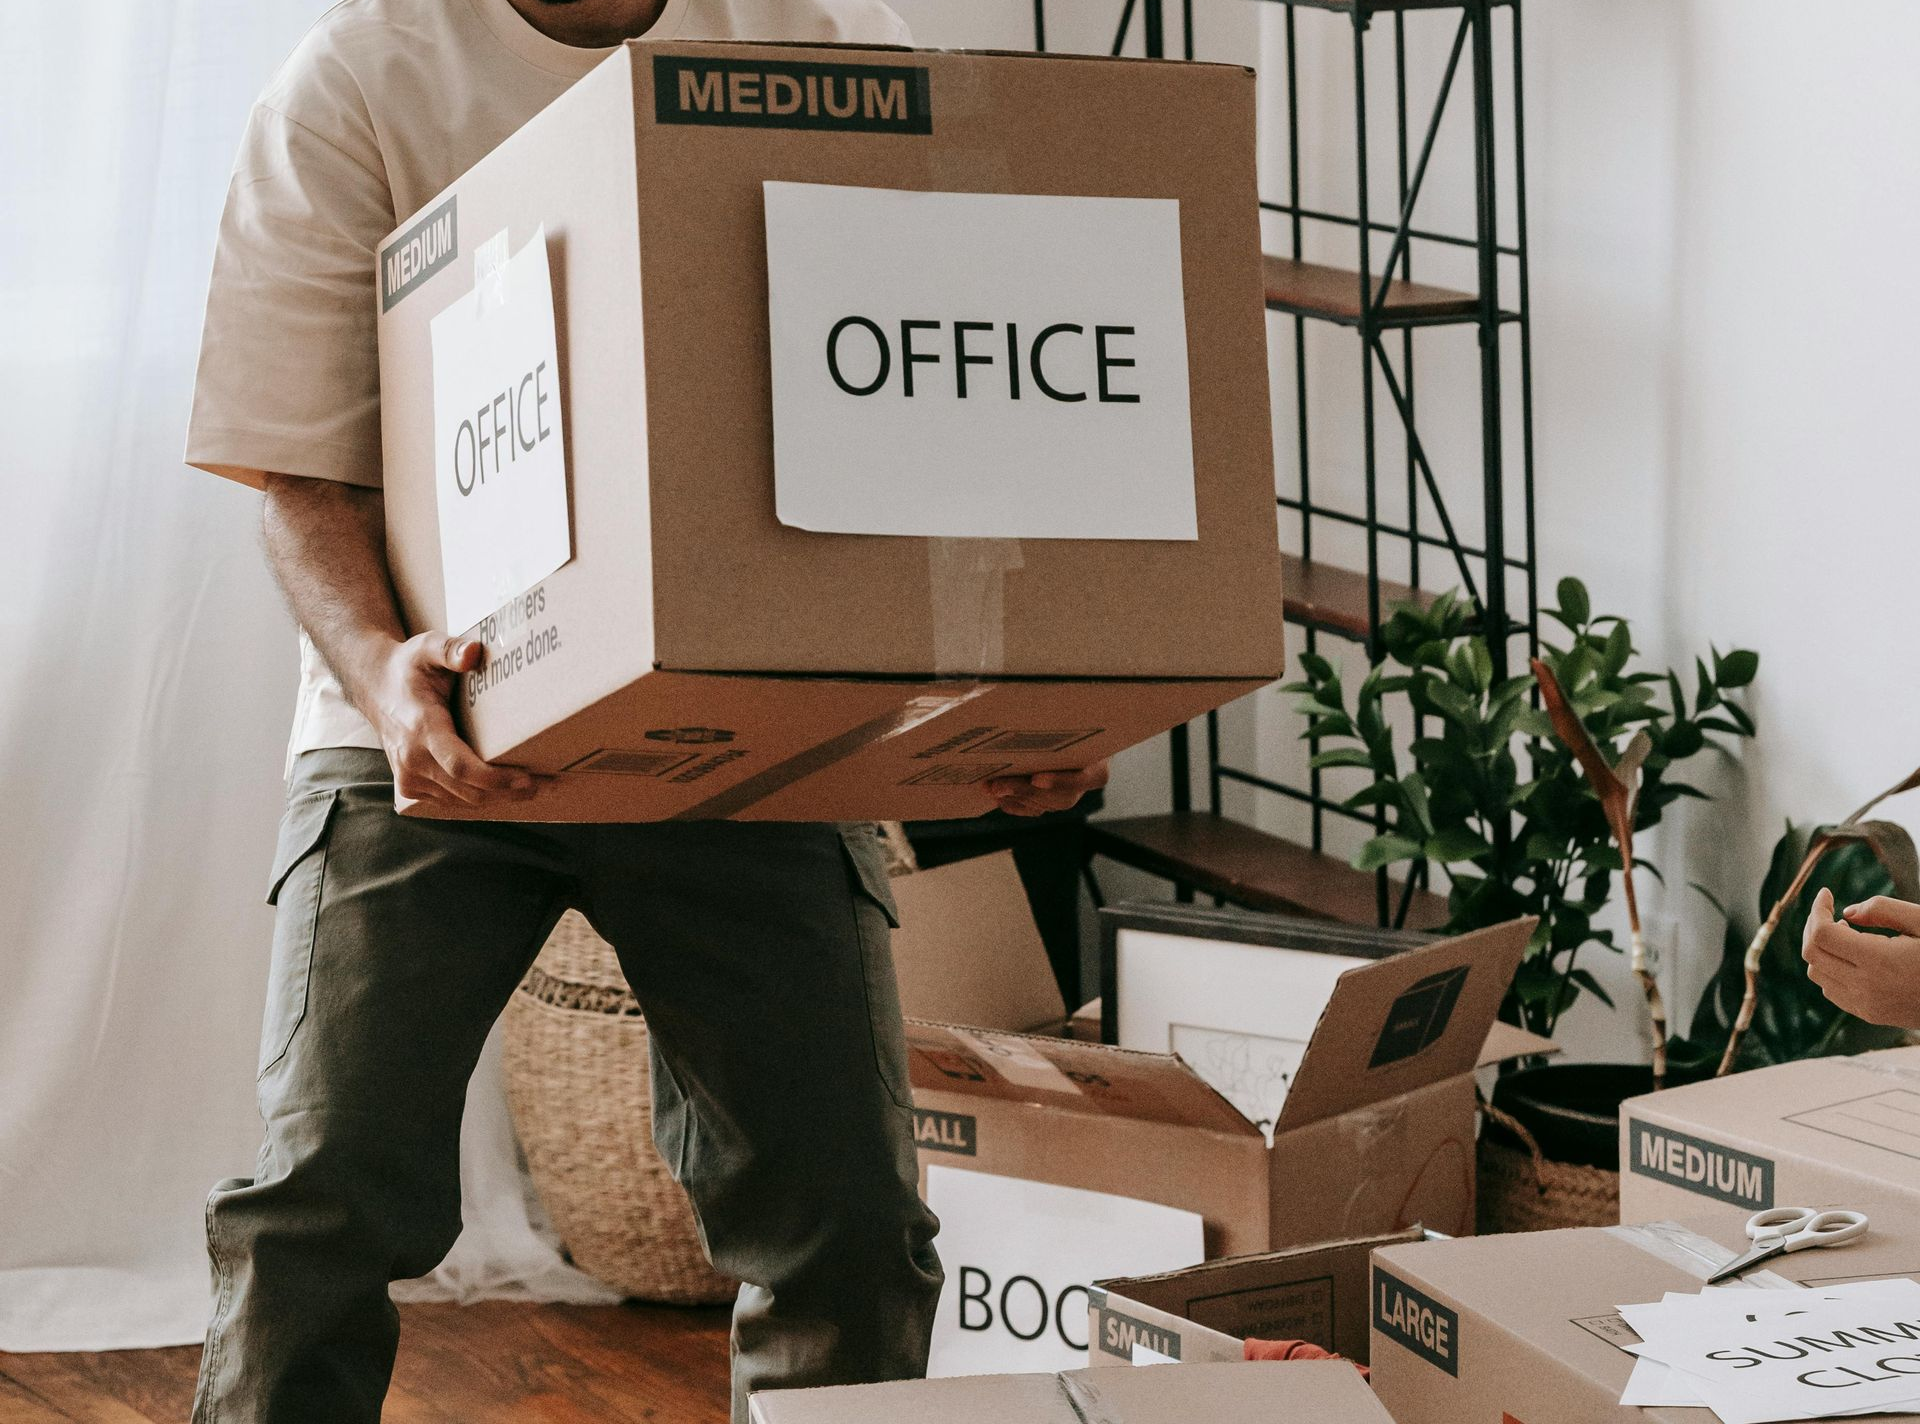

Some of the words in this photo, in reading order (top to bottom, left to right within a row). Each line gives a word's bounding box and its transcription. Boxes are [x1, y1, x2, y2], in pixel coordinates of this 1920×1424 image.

[678, 69, 909, 122] MEDIUM
[386, 210, 452, 297] MEDIUM
[826, 315, 1141, 404] OFFICE
[454, 360, 552, 497] OFFICE
[468, 665, 489, 708] get
[491, 645, 523, 688] more
[913, 1115, 968, 1147] ALL
[1640, 1131, 1763, 1203] MEDIUM
[1380, 1281, 1450, 1359] LARGE
